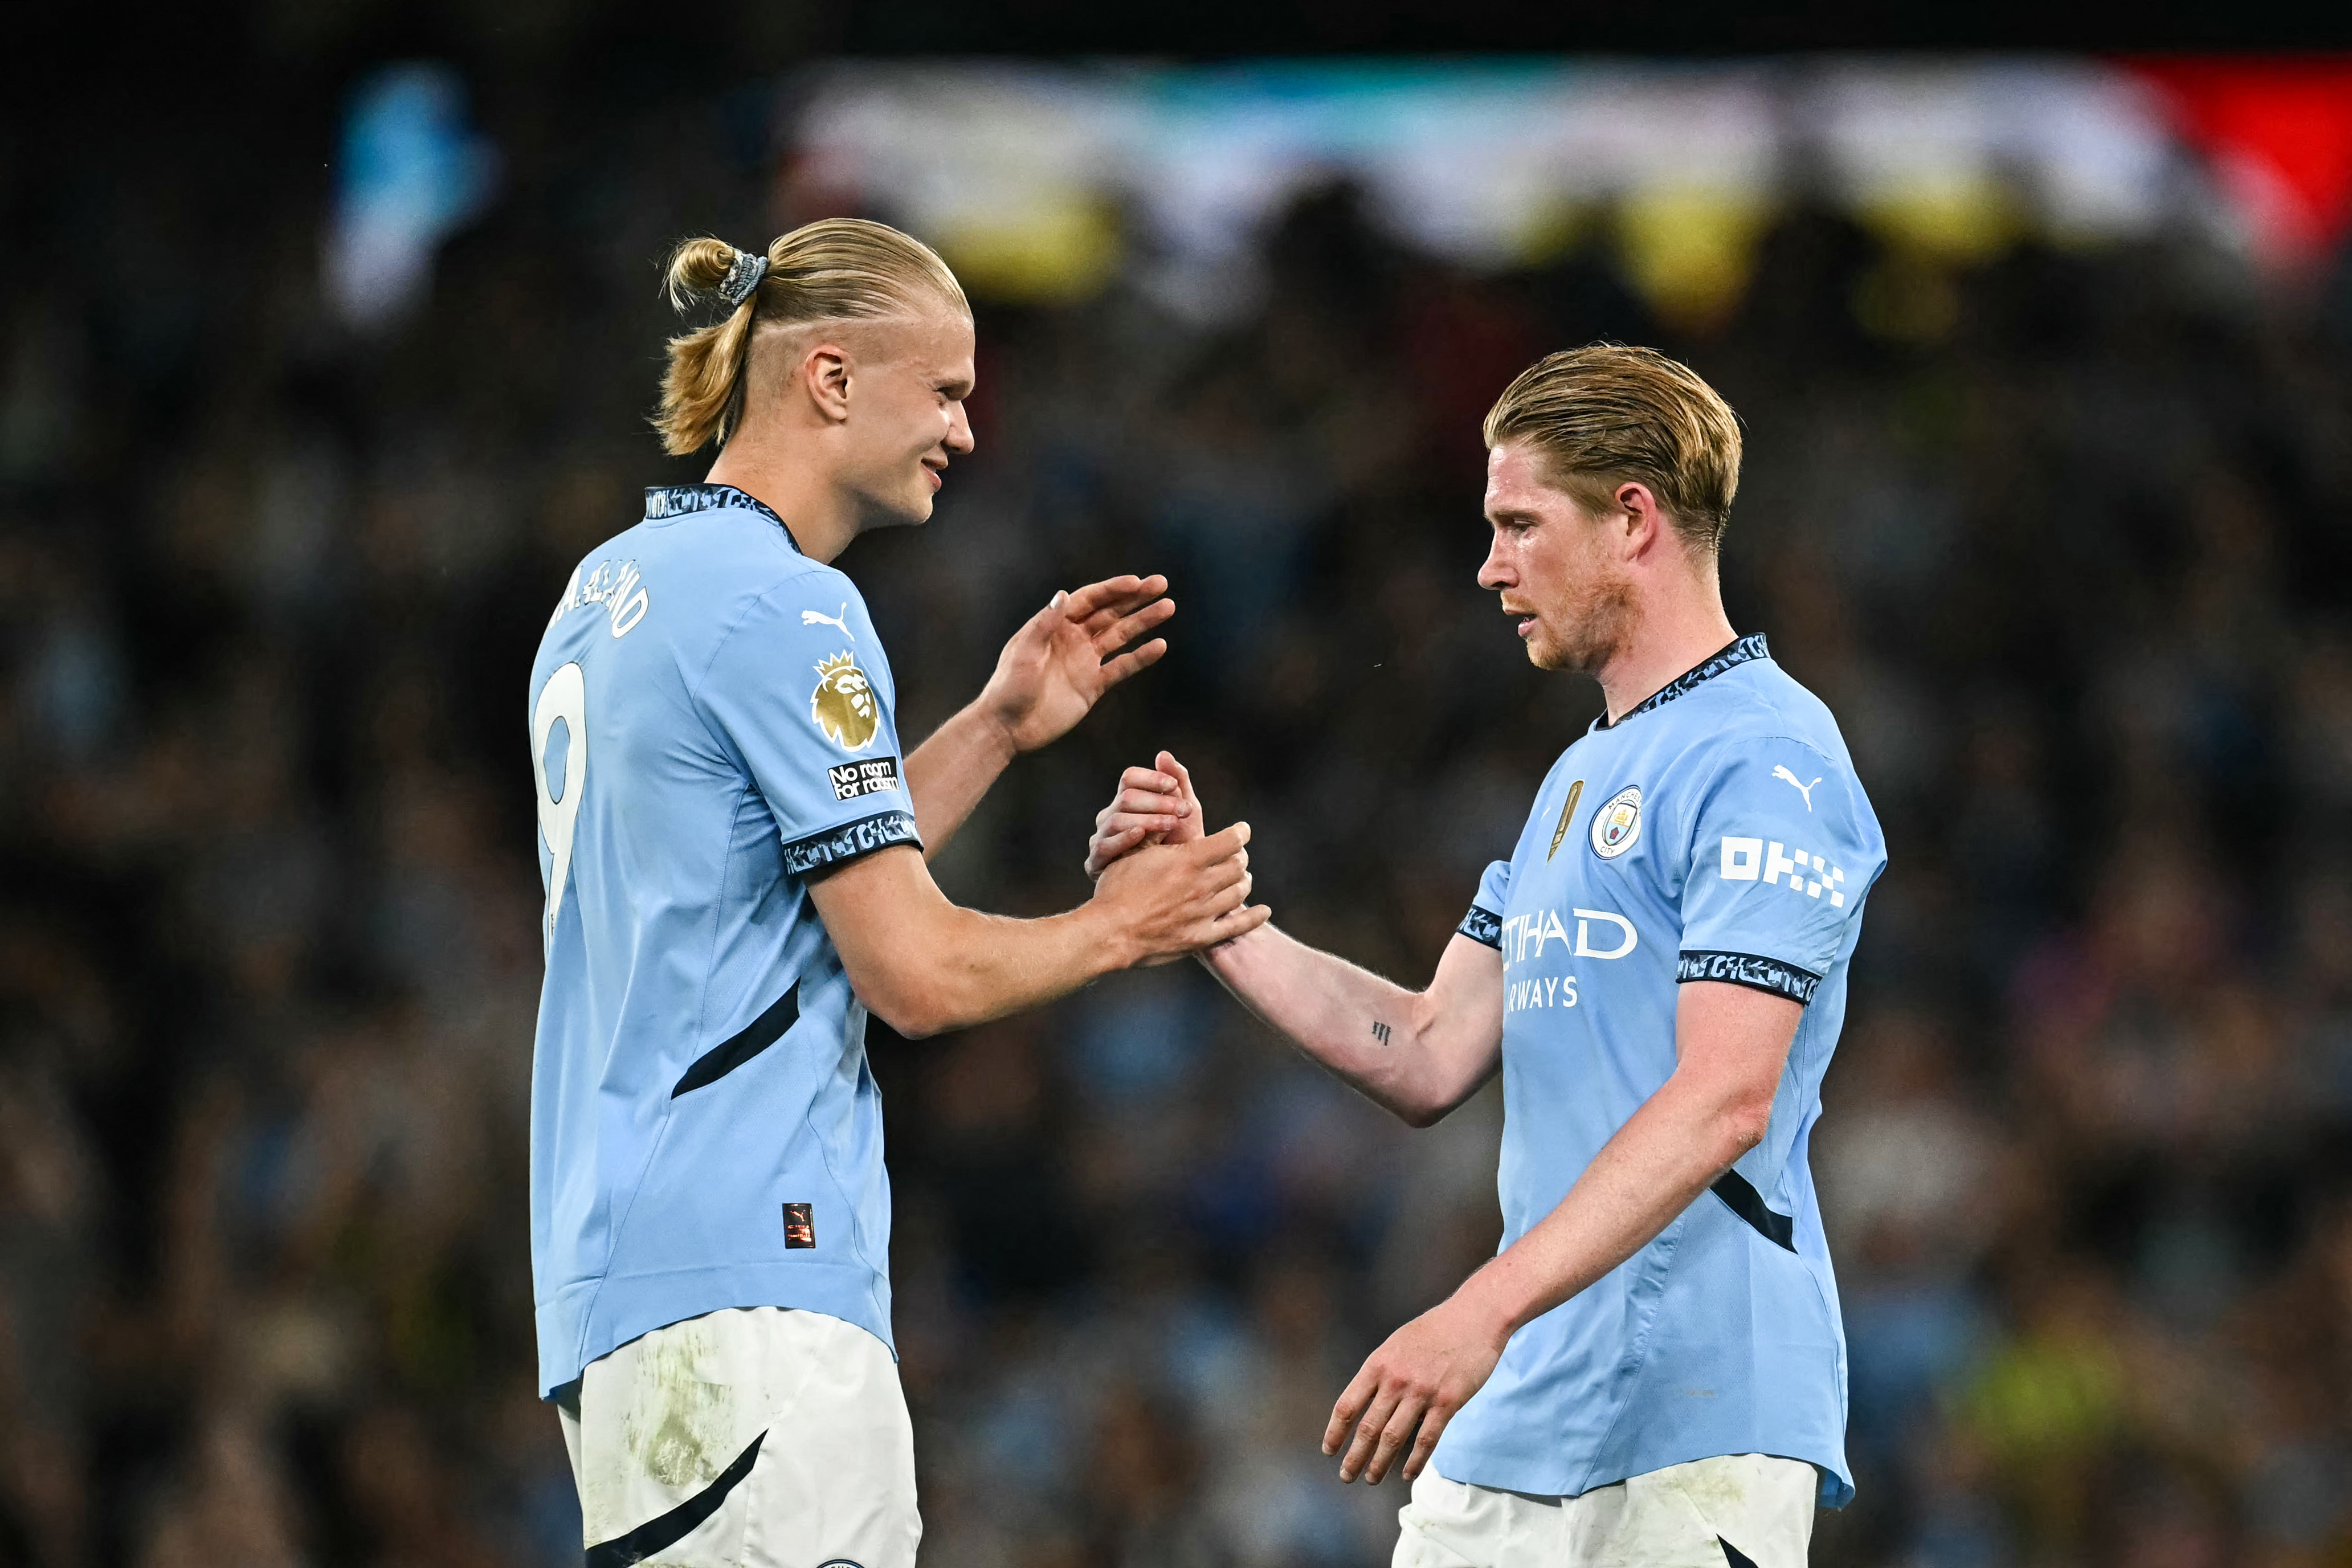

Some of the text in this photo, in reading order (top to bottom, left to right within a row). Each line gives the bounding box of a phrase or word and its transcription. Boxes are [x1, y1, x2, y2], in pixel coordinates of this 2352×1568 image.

[828, 761, 891, 786] No room
[533, 660, 587, 954] 9
[1600, 846, 1615, 855] CITY
[1720, 836, 1844, 908] OKX
[1508, 976, 1578, 1012] RWAYS
